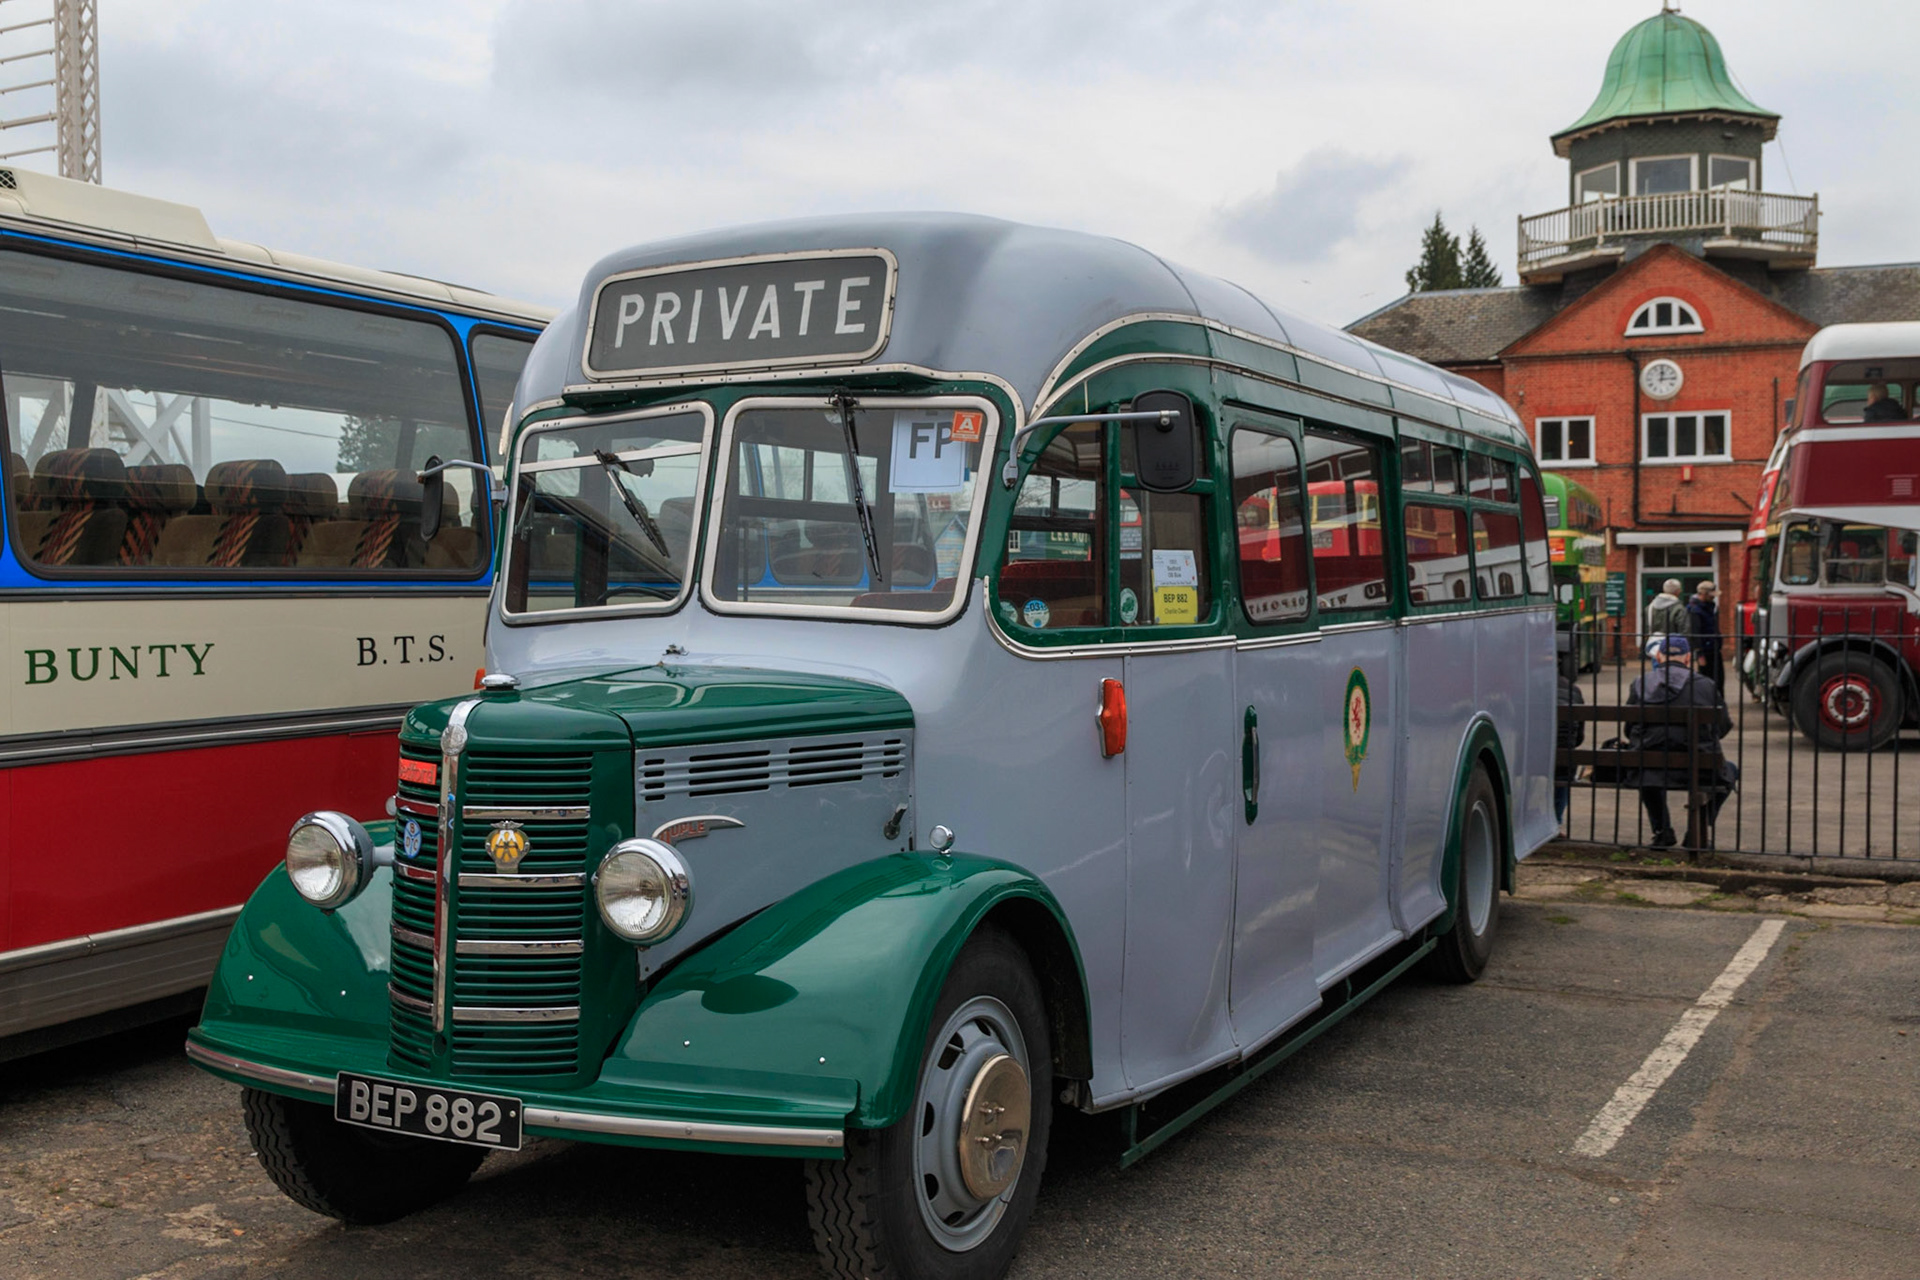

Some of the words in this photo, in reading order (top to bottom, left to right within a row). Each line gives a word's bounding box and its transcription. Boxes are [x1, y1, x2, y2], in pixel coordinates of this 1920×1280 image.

[614, 276, 870, 348] PRIVATE
[909, 422, 953, 459] FP
[959, 417, 974, 431] A
[1163, 594, 1175, 603] BEP
[1177, 594, 1188, 603] 882
[24, 643, 215, 685] BUNTY
[356, 634, 454, 666] B.T.S.
[350, 1080, 417, 1127] BEP
[425, 1094, 502, 1143] 882
